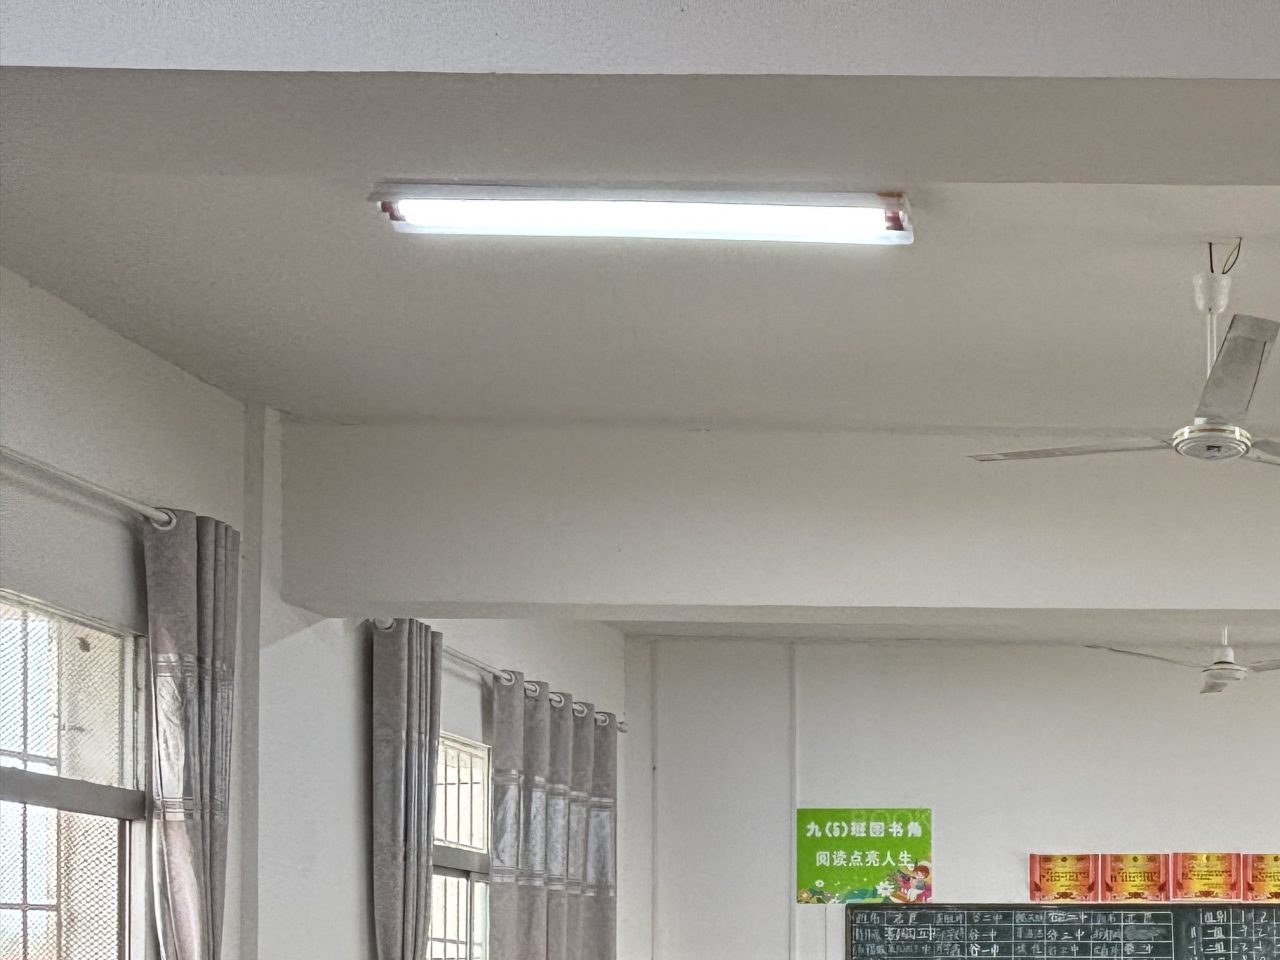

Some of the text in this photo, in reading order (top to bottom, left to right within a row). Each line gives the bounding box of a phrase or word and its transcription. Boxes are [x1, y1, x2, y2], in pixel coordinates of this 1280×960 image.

[816, 851, 914, 867] 阅读点亮人生
[1260, 911, 1268, 923] 2
